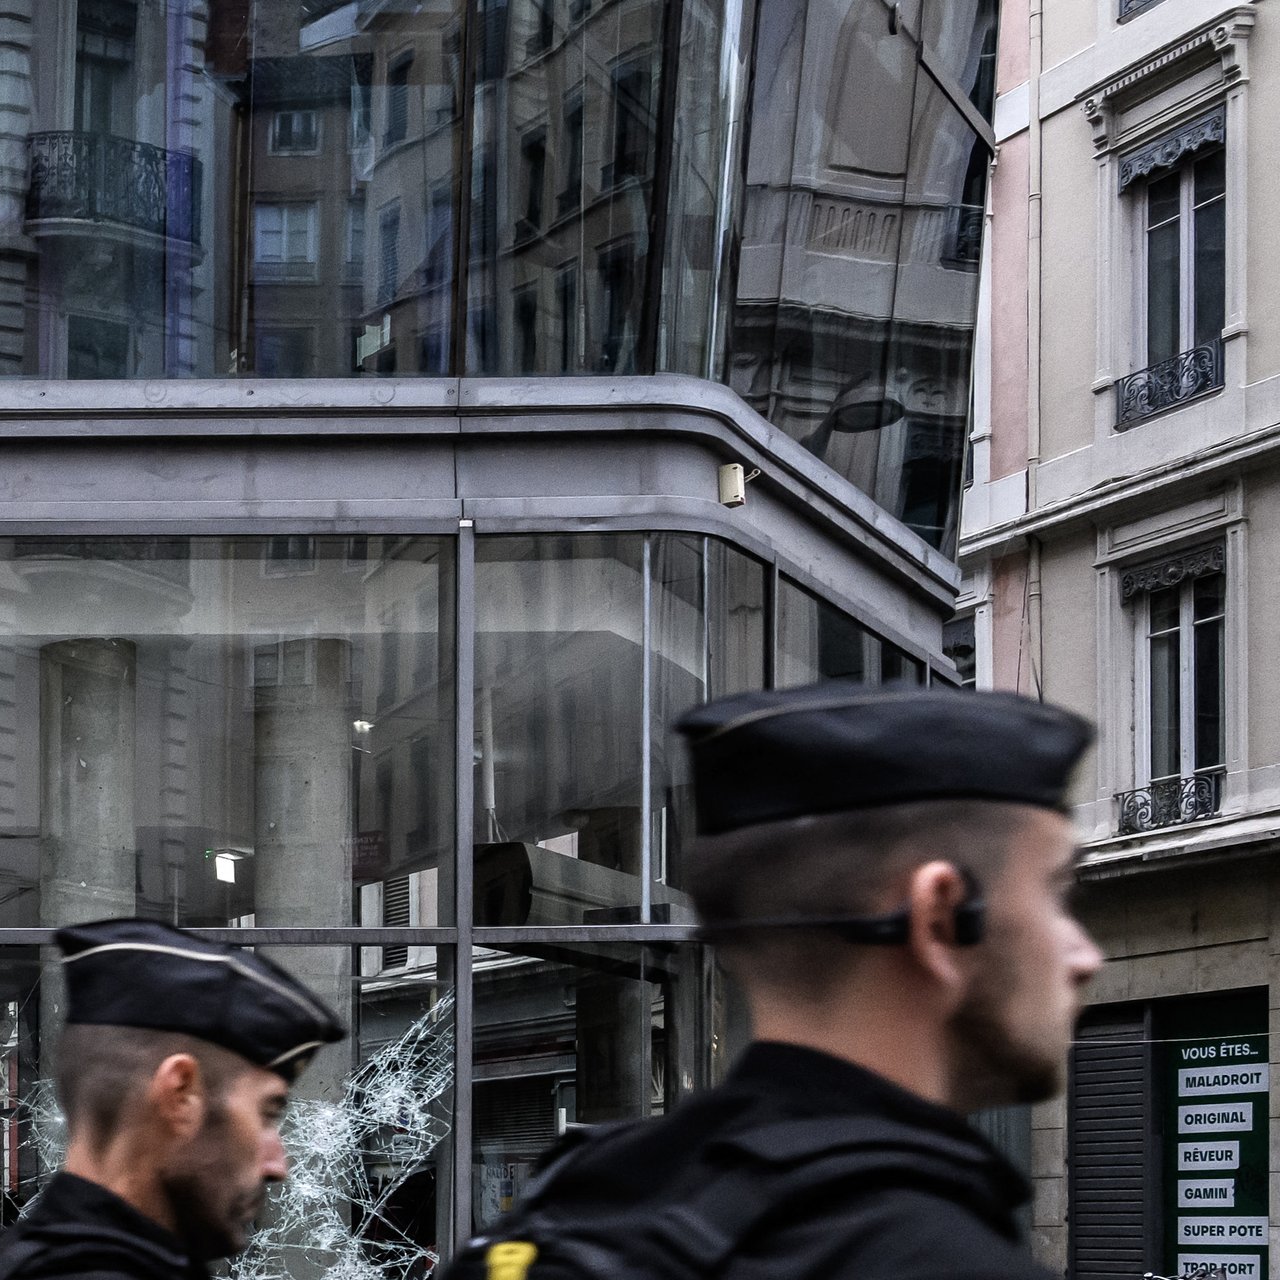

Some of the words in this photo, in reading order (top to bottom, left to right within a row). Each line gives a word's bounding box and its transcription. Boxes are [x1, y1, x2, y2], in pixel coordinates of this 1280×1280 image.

[1182, 1046, 1217, 1060] VOUS
[1185, 1072, 1262, 1089] MALADROIT
[1184, 1111, 1247, 1126] ORIGINAL
[1184, 1147, 1234, 1163] RÊVEUR
[1184, 1187, 1228, 1200] GAMIN
[1183, 1225, 1225, 1237] SUPER
[1229, 1225, 1263, 1237] POTE
